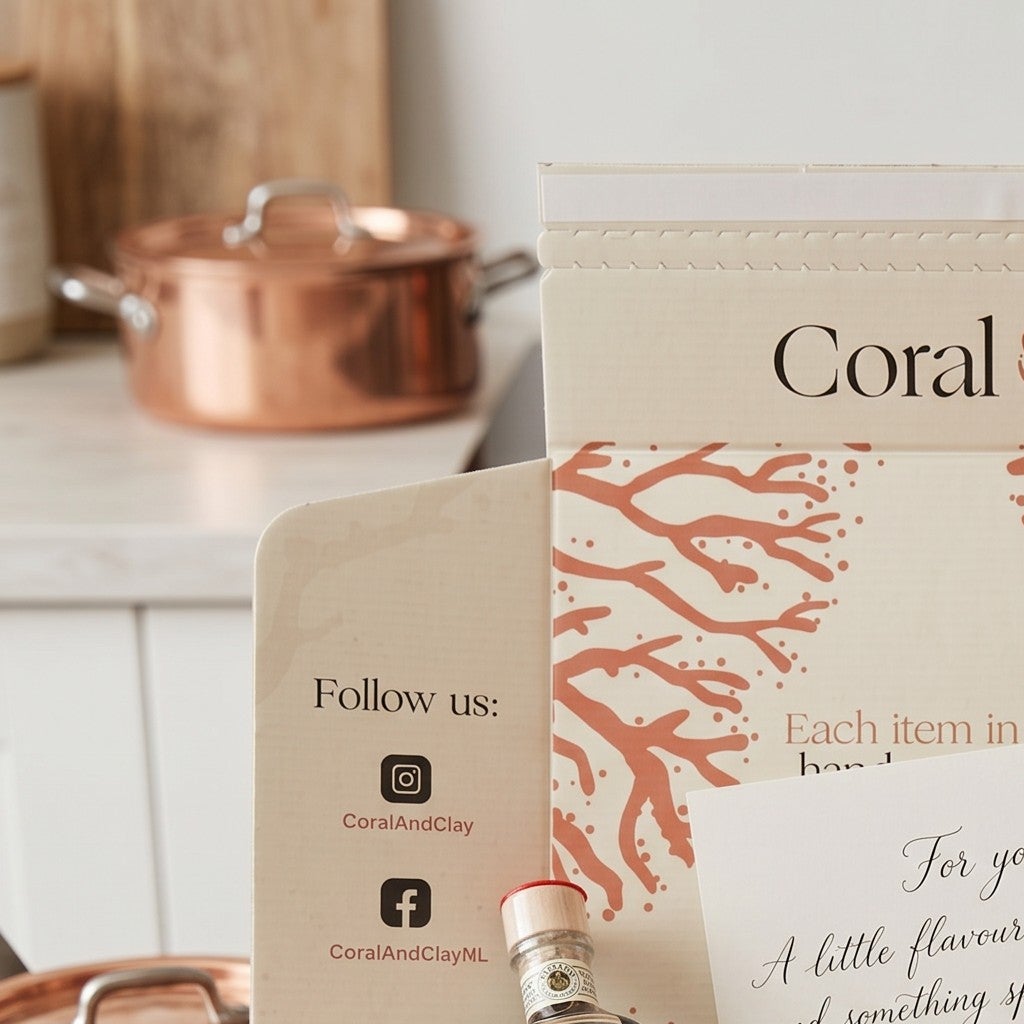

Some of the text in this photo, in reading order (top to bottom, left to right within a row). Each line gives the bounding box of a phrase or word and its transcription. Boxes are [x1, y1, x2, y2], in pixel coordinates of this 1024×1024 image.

[774, 315, 999, 399] Coral
[313, 677, 499, 717] Follow us:
[784, 709, 879, 745] Each
[891, 712, 972, 745] item
[986, 713, 1019, 745] in
[342, 813, 474, 836] CoralAndClay
[901, 826, 978, 893] For
[329, 944, 489, 966] CoralAndClayML
[751, 935, 797, 990] A
[804, 926, 895, 979] little
